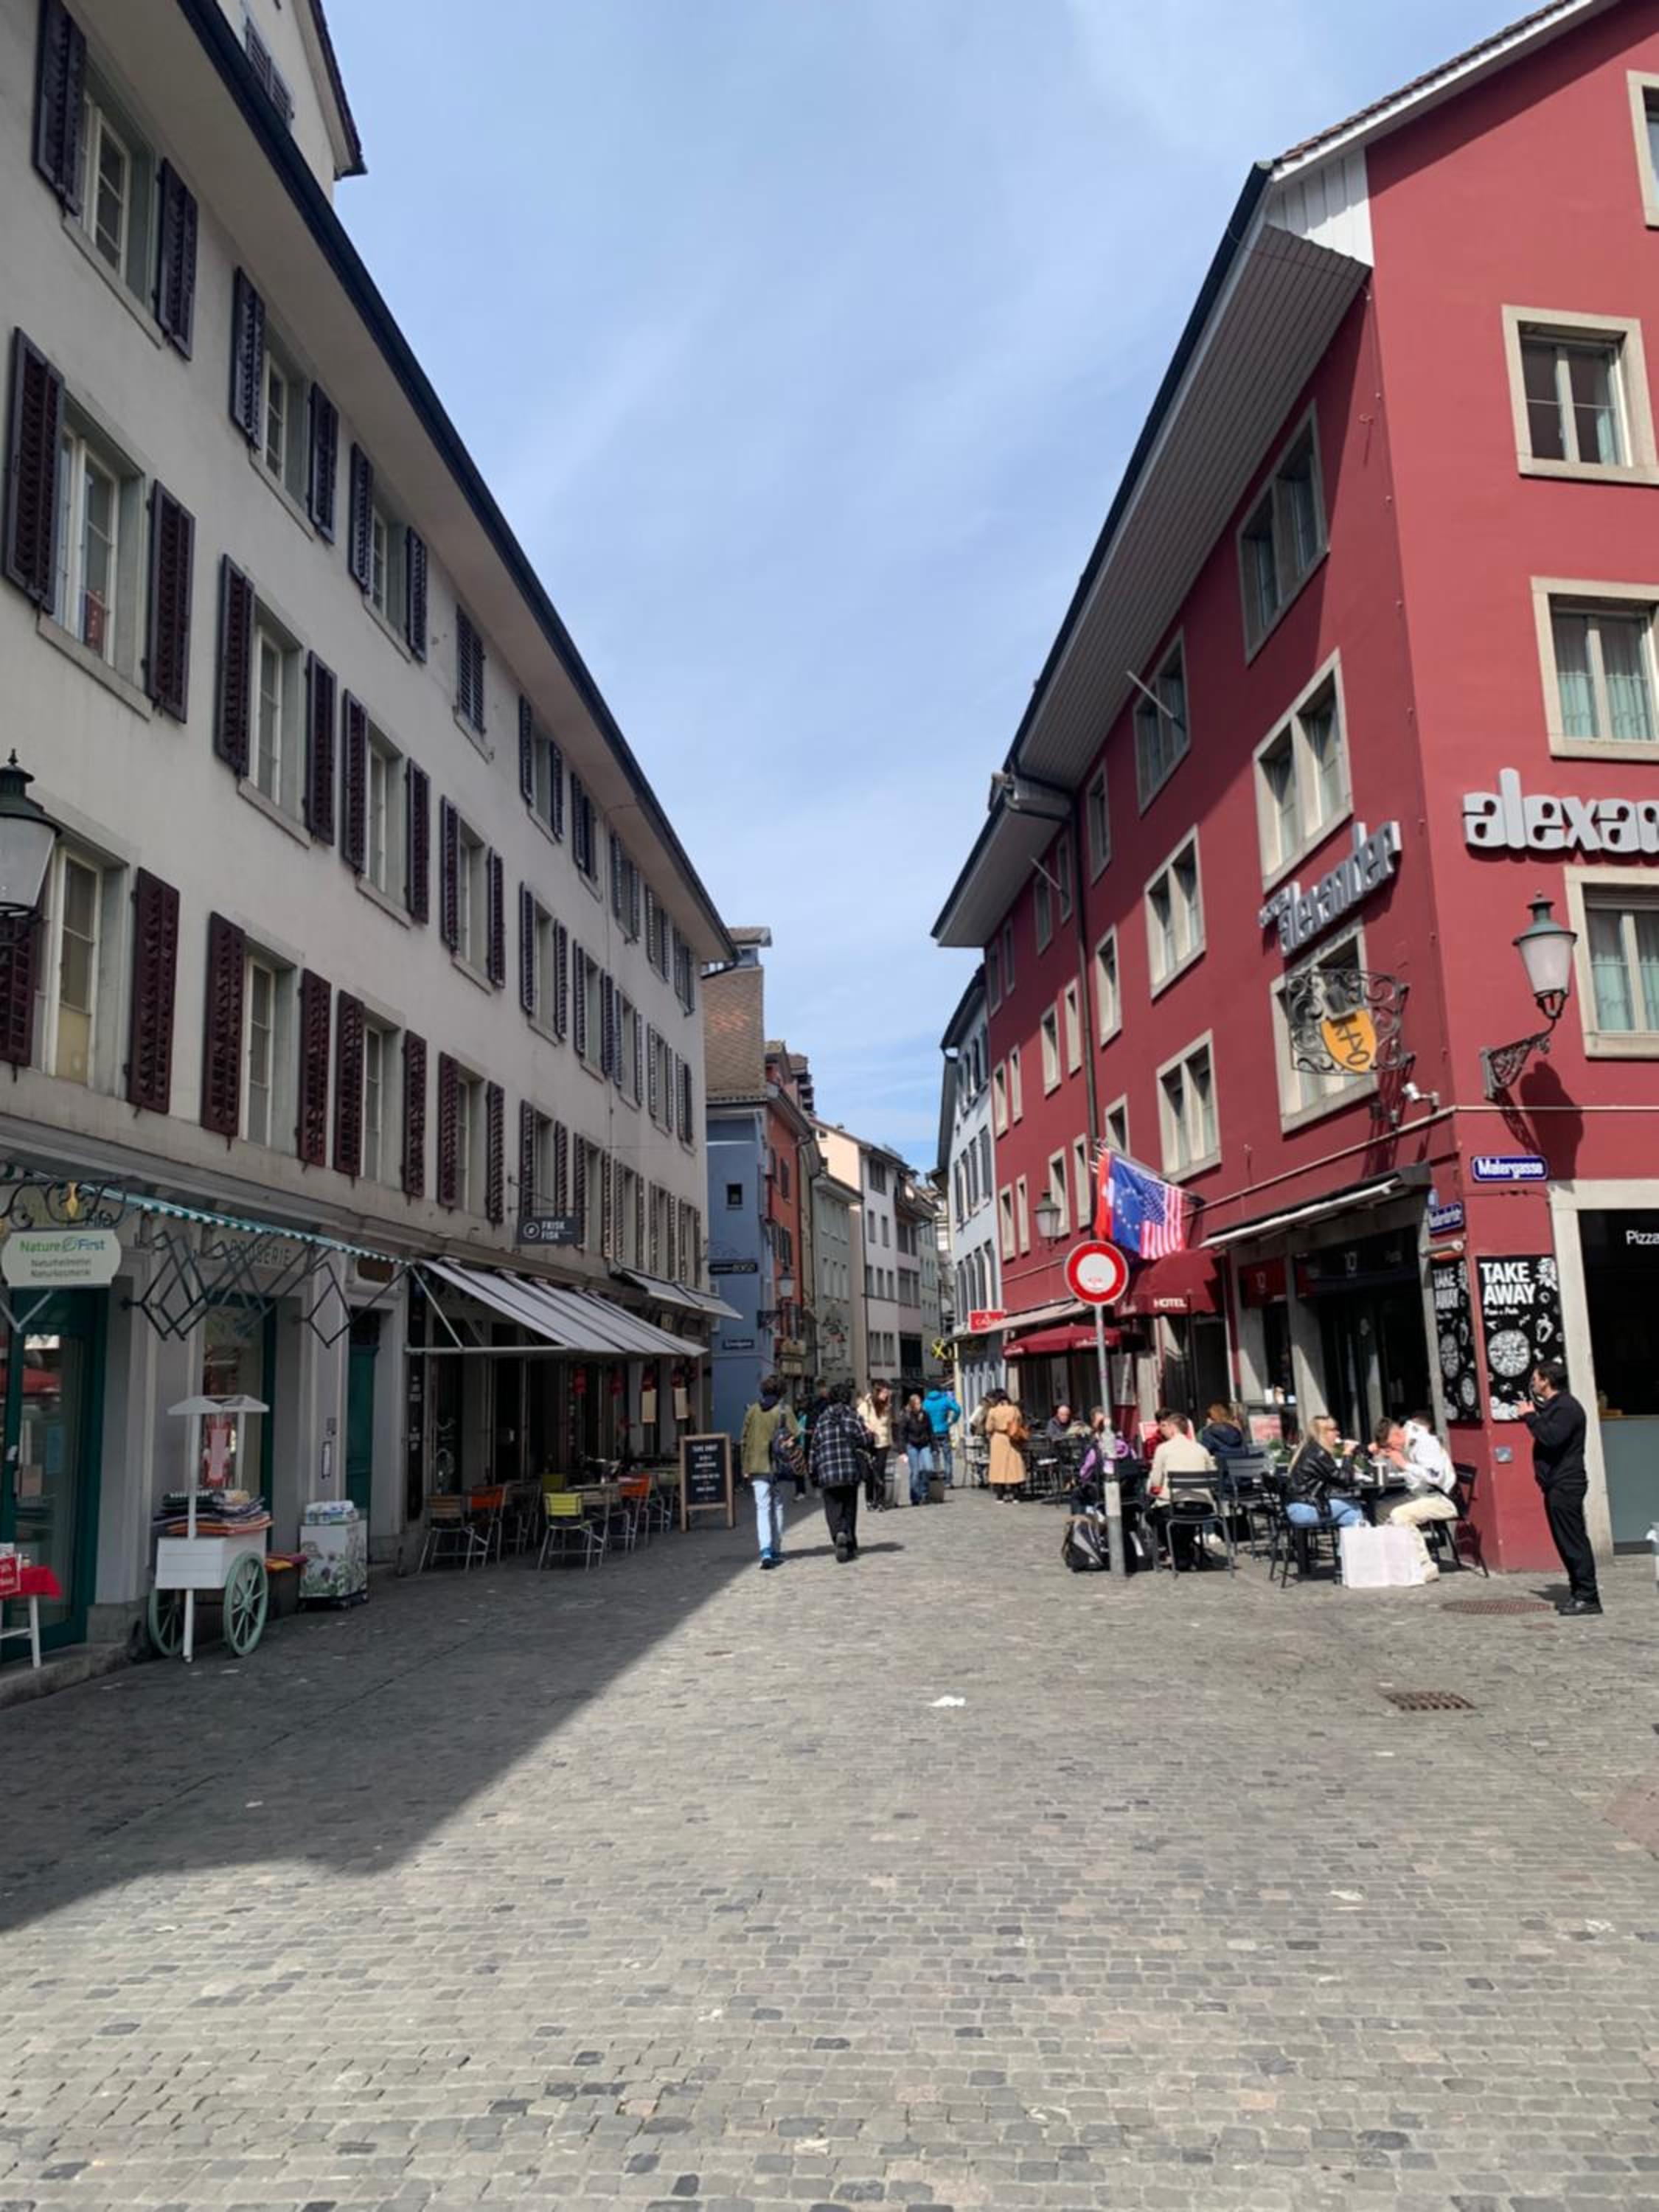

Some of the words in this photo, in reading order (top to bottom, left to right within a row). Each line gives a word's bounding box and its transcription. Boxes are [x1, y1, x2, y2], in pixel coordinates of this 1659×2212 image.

[1278, 820, 1402, 956] alexander
[1478, 1158, 1544, 1180] Malergasse
[1433, 1267, 1456, 1289] TAKE
[1480, 1262, 1531, 1284] TAKE
[1152, 1297, 1188, 1309] HOTEL
[1435, 1288, 1459, 1310] AWAY
[1484, 1283, 1536, 1306] AWAY
